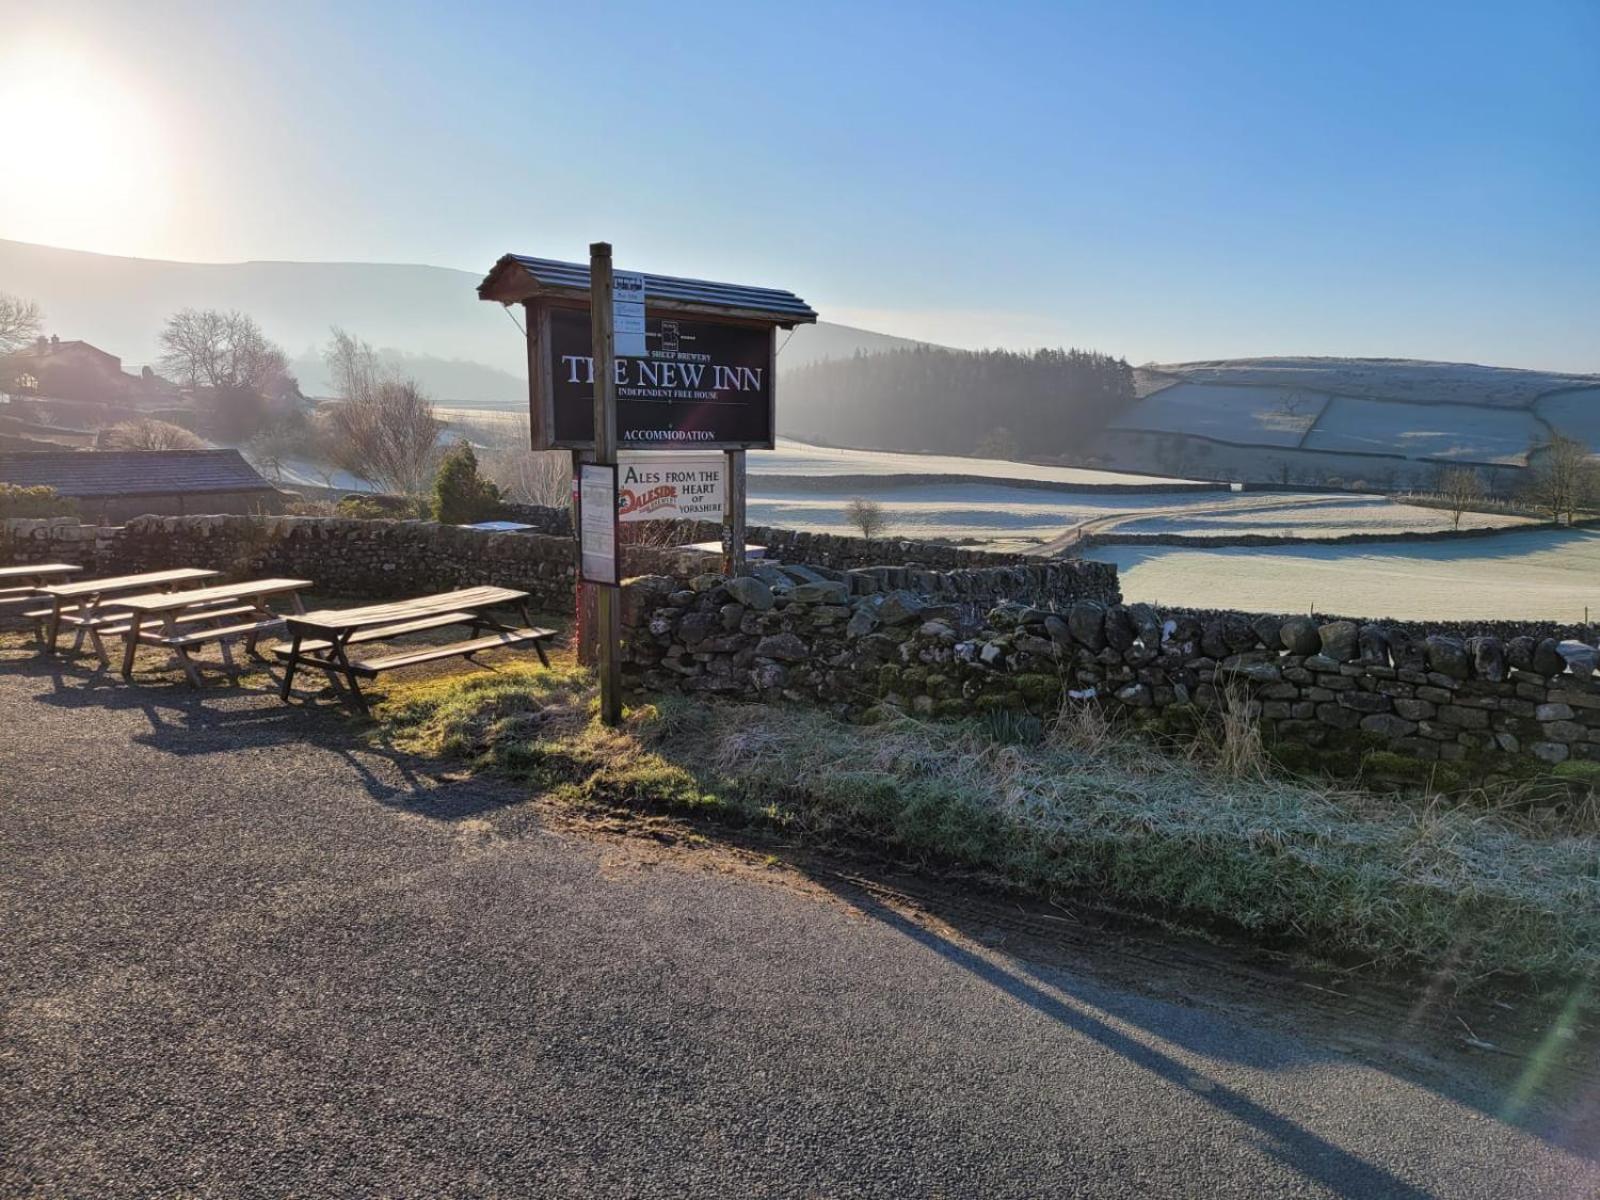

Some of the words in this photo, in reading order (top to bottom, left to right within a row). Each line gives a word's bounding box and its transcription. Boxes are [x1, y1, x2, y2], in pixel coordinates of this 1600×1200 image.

[637, 360, 705, 389] NEW
[712, 365, 763, 392] INN
[618, 387, 672, 399] INDEPENDENT
[673, 389, 691, 399] FREE
[694, 391, 718, 400] HOUSE
[624, 429, 715, 441] ACCOMMODATION
[665, 471, 696, 483] FROM
[699, 471, 720, 482] THE
[682, 484, 715, 495] HEART
[679, 503, 722, 514] YORKSHIRE
